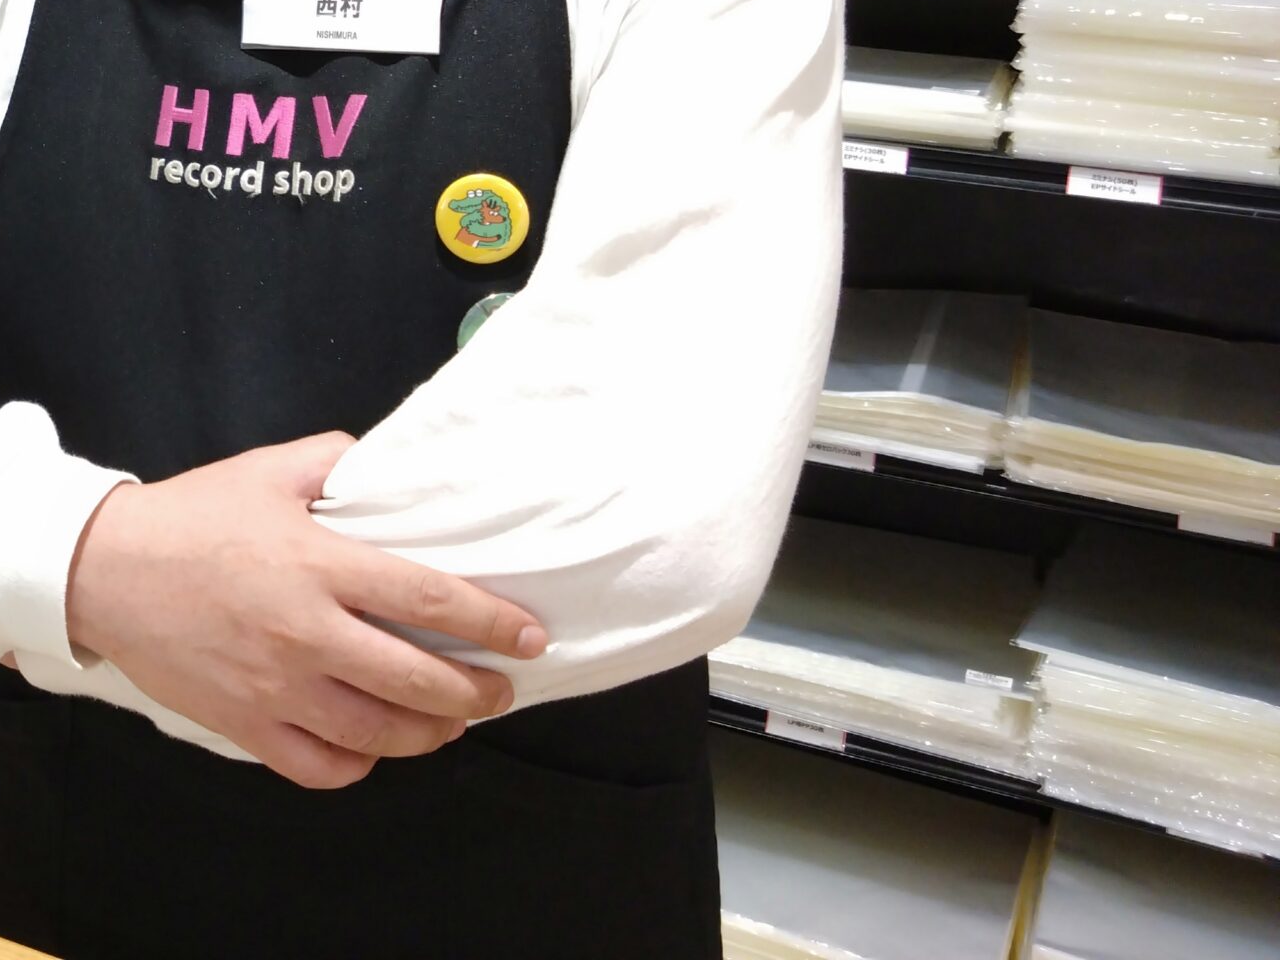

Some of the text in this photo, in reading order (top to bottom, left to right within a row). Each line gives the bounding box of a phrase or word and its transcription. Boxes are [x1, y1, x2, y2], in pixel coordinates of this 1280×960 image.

[316, 30, 358, 40] NISHIMURA
[154, 84, 368, 160] HMV
[149, 154, 356, 203] record shop
